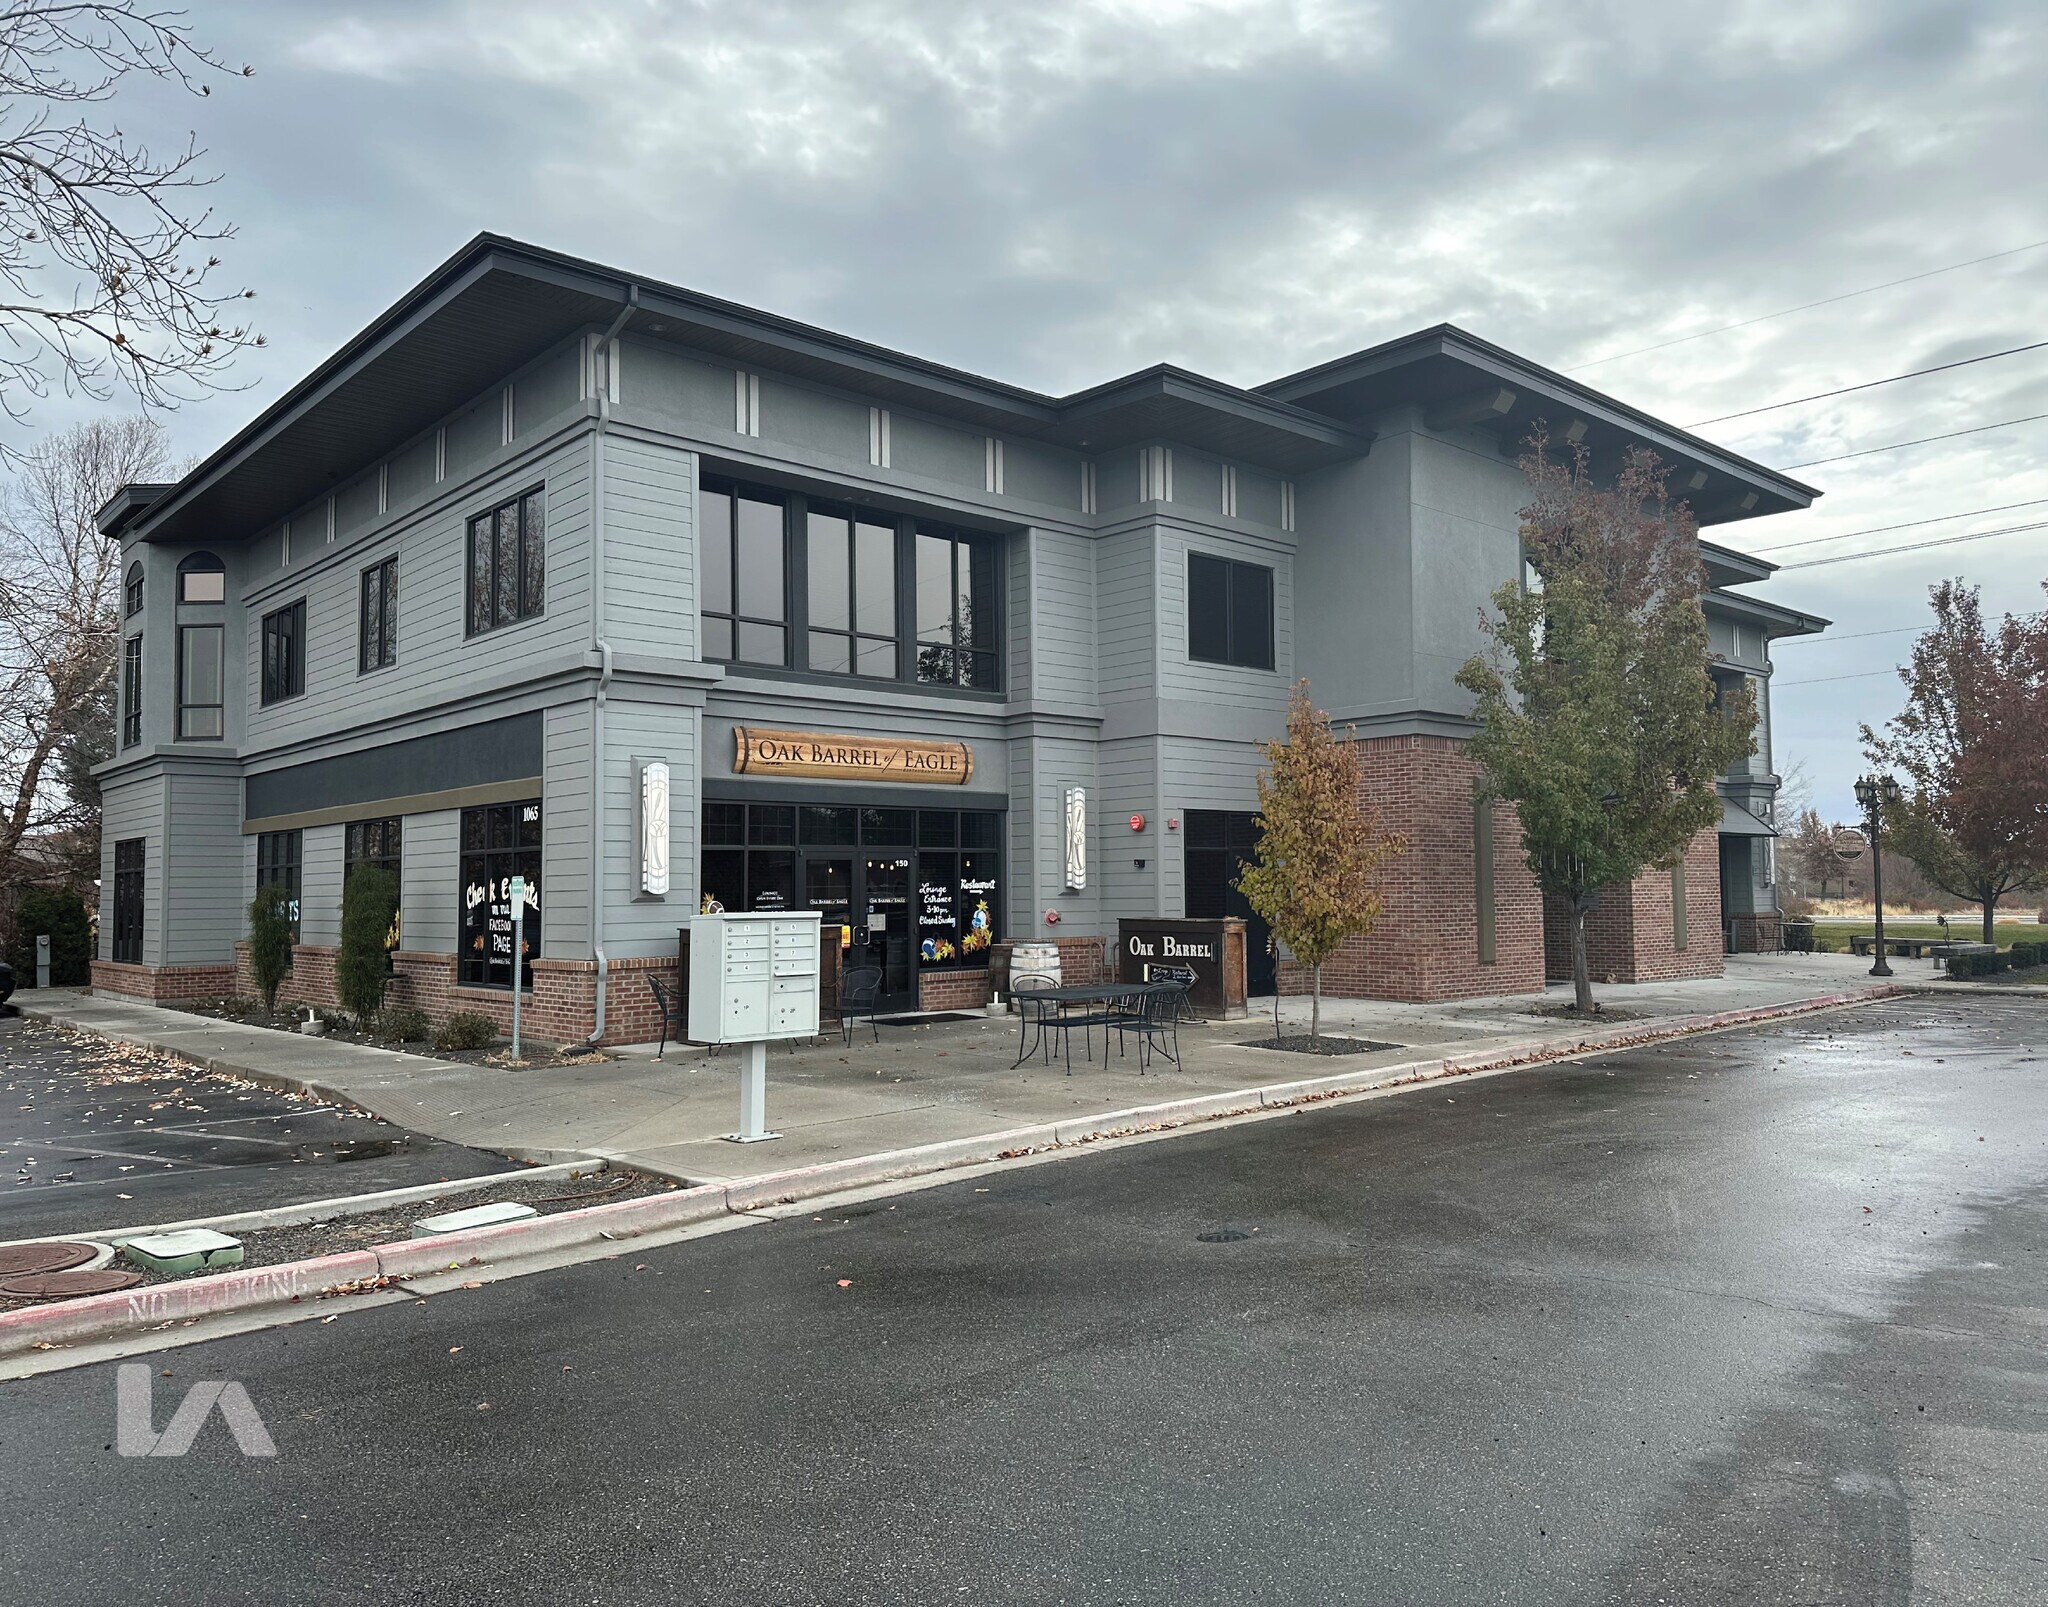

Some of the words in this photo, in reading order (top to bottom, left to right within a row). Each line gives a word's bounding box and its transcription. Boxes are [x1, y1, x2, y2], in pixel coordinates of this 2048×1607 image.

[758, 740, 805, 762] OAK
[811, 744, 882, 767] BARREL
[882, 748, 902, 773] of
[904, 750, 958, 771] EAGLE
[523, 806, 539, 822] 1065
[919, 882, 947, 897] Lounge
[960, 878, 996, 890] Restaurant
[923, 894, 952, 904] Entrance
[489, 918, 511, 932] FACEBOO
[919, 915, 938, 925] Closed
[938, 915, 956, 928] Sunday
[493, 934, 511, 953] PAGE
[1129, 936, 1155, 956] OAK
[1162, 936, 1211, 957] BARREL
[128, 1292, 168, 1322] NO
